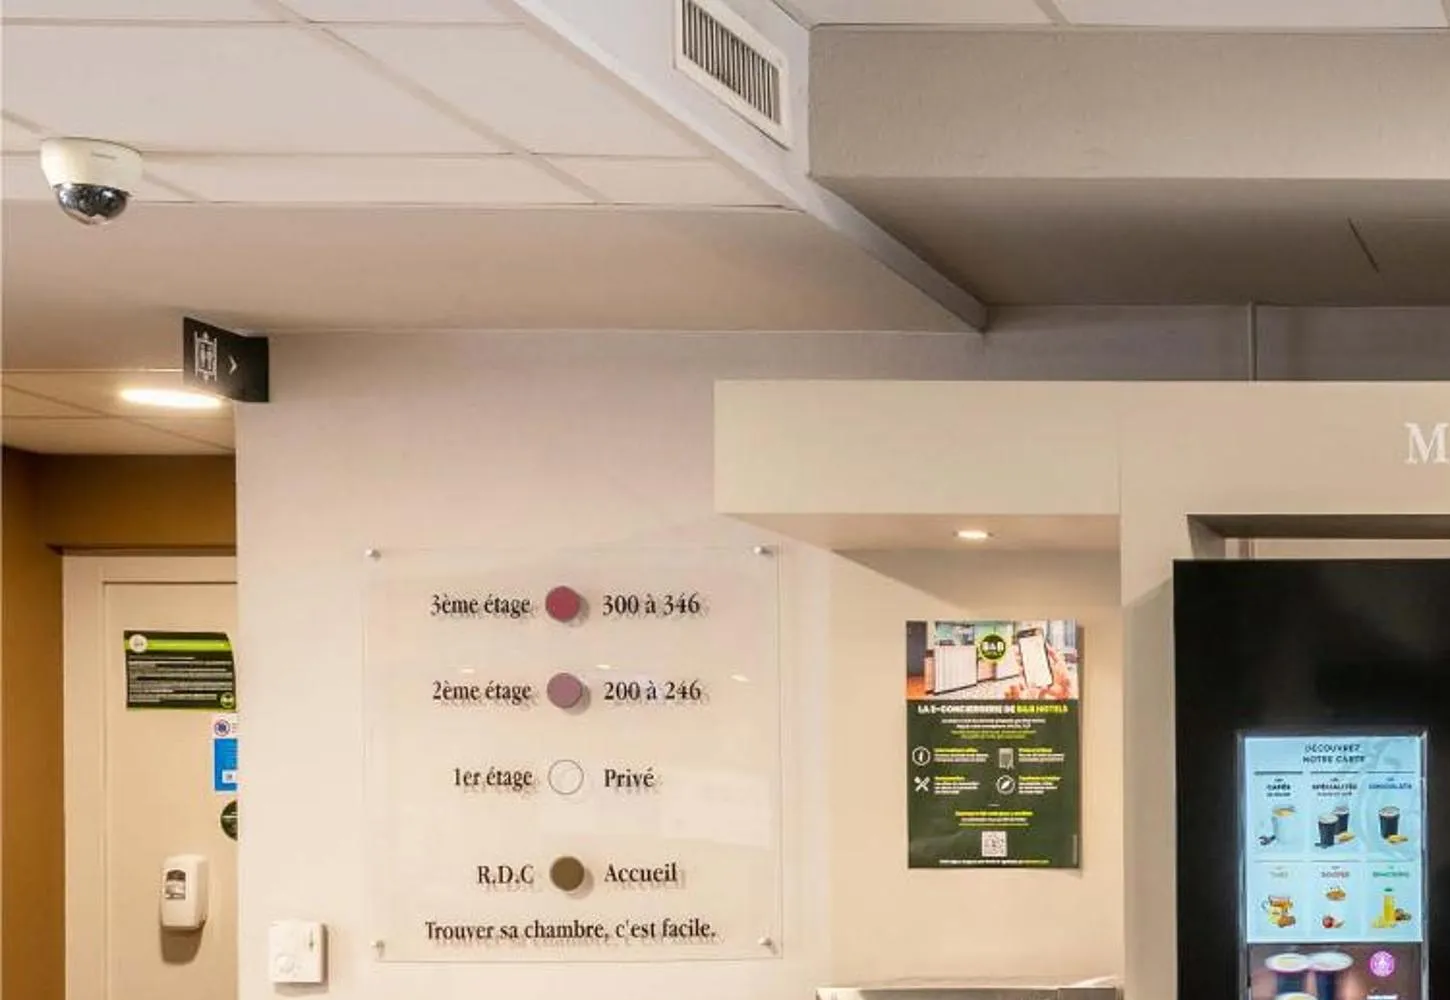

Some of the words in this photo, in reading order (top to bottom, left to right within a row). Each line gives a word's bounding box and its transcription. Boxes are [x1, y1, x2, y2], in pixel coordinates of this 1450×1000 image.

[431, 594, 479, 616] 3ème
[484, 593, 531, 619] étage
[602, 594, 640, 616] 300
[645, 593, 657, 615] à
[663, 592, 702, 616] 346
[432, 680, 481, 701] 2ème
[485, 680, 532, 706] étage
[603, 681, 641, 701] 200
[646, 680, 657, 701] à
[664, 680, 703, 701] 246
[453, 767, 481, 788] 1er
[486, 766, 533, 792] étage
[604, 767, 655, 788] Privé
[604, 862, 678, 883] Accueil
[424, 920, 494, 941] Trouver
[499, 924, 519, 940] sa
[523, 919, 610, 943] chambre,
[615, 919, 656, 940] c'est
[662, 917, 717, 939] facile.
